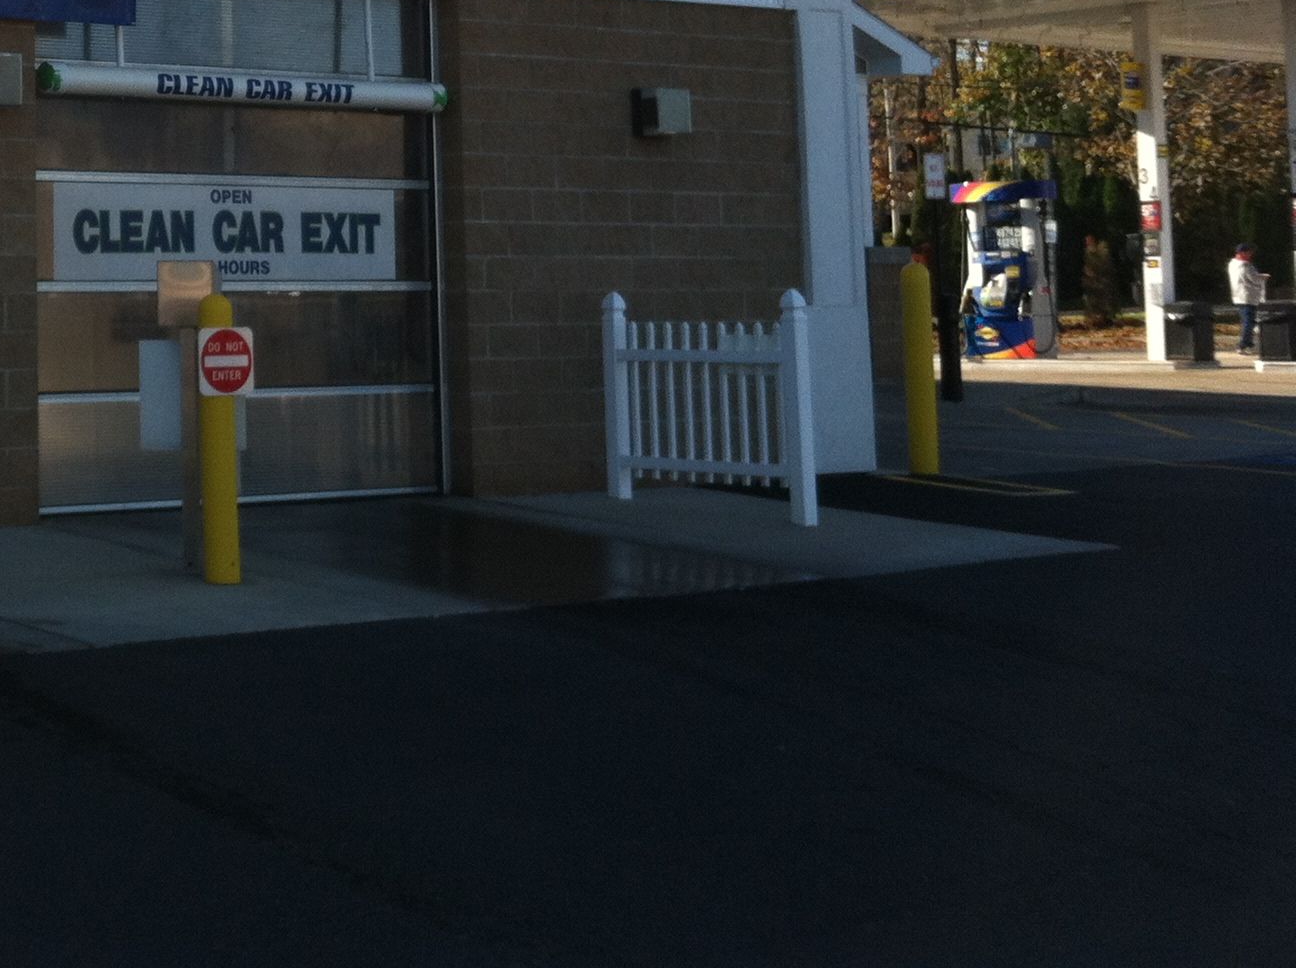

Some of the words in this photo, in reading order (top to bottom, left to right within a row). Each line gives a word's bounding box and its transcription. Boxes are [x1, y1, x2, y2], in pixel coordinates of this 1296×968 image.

[157, 73, 234, 98] CLEAN
[245, 79, 293, 101] CAR
[305, 82, 355, 104] EXIT
[210, 189, 252, 205] OPEN
[72, 208, 195, 254] CLEAN
[212, 210, 284, 254] CAR
[300, 212, 380, 254] EXIT
[218, 260, 270, 275] HOURS
[207, 342, 221, 352] DO
[226, 341, 244, 352] NOT
[212, 370, 242, 381] ENTER
